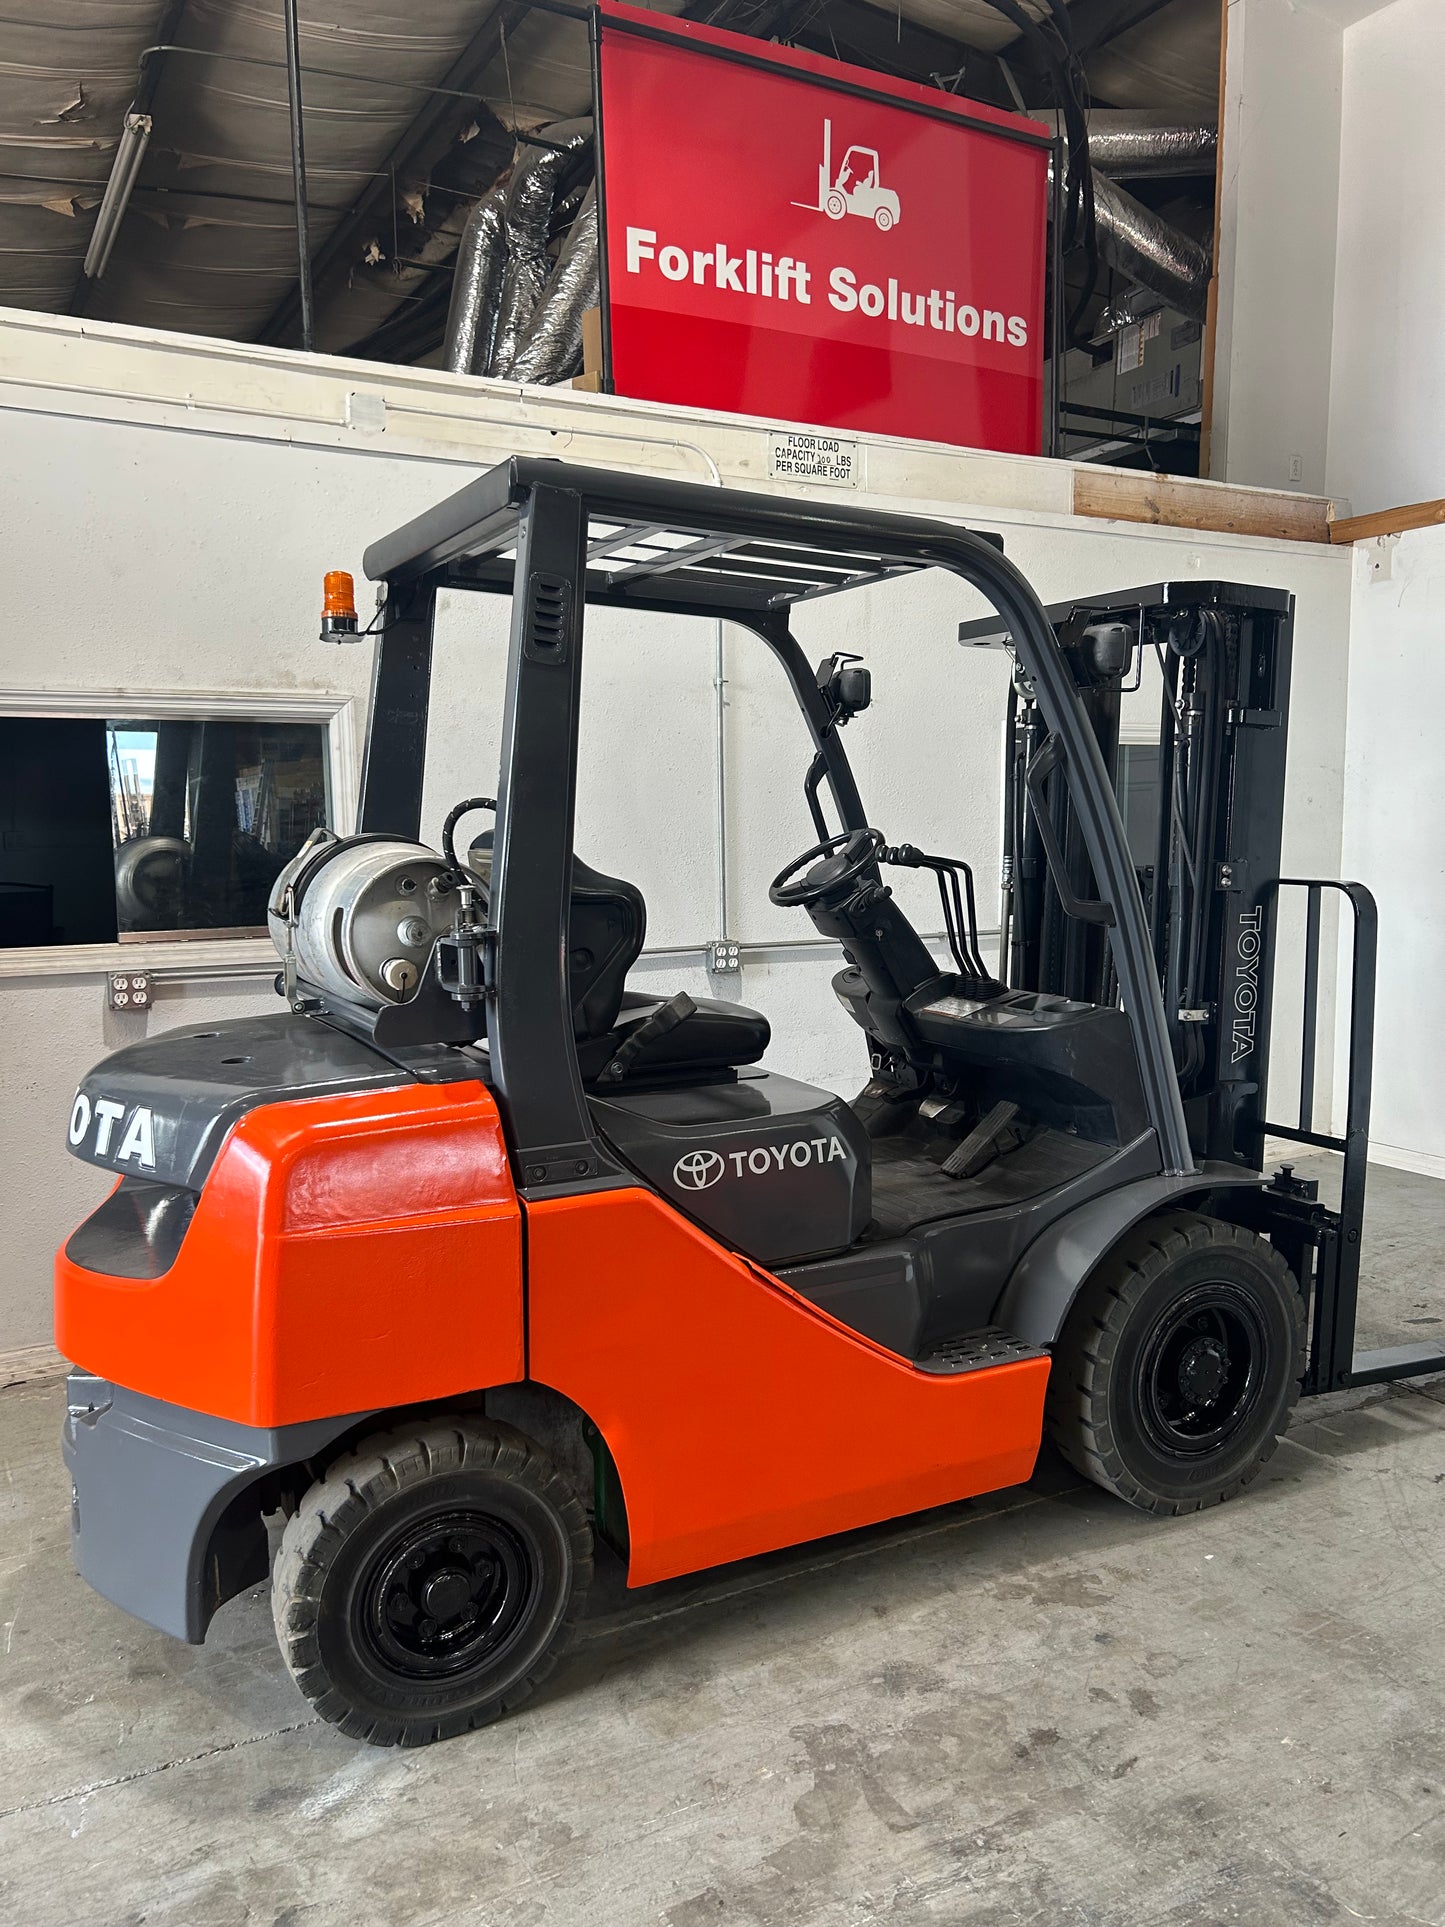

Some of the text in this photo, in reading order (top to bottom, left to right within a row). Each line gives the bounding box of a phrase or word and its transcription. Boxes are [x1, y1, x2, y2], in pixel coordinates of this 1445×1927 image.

[626, 226, 1028, 347] Forklift Solutions
[775, 447, 816, 462] CAPACITY
[836, 455, 852, 467] LBS
[788, 436, 840, 452] FLOOR LOAD
[775, 460, 851, 479] PER SQUARE FOOT
[1231, 905, 1263, 1064] TOYOTA
[728, 1136, 847, 1178] TOYOTA
